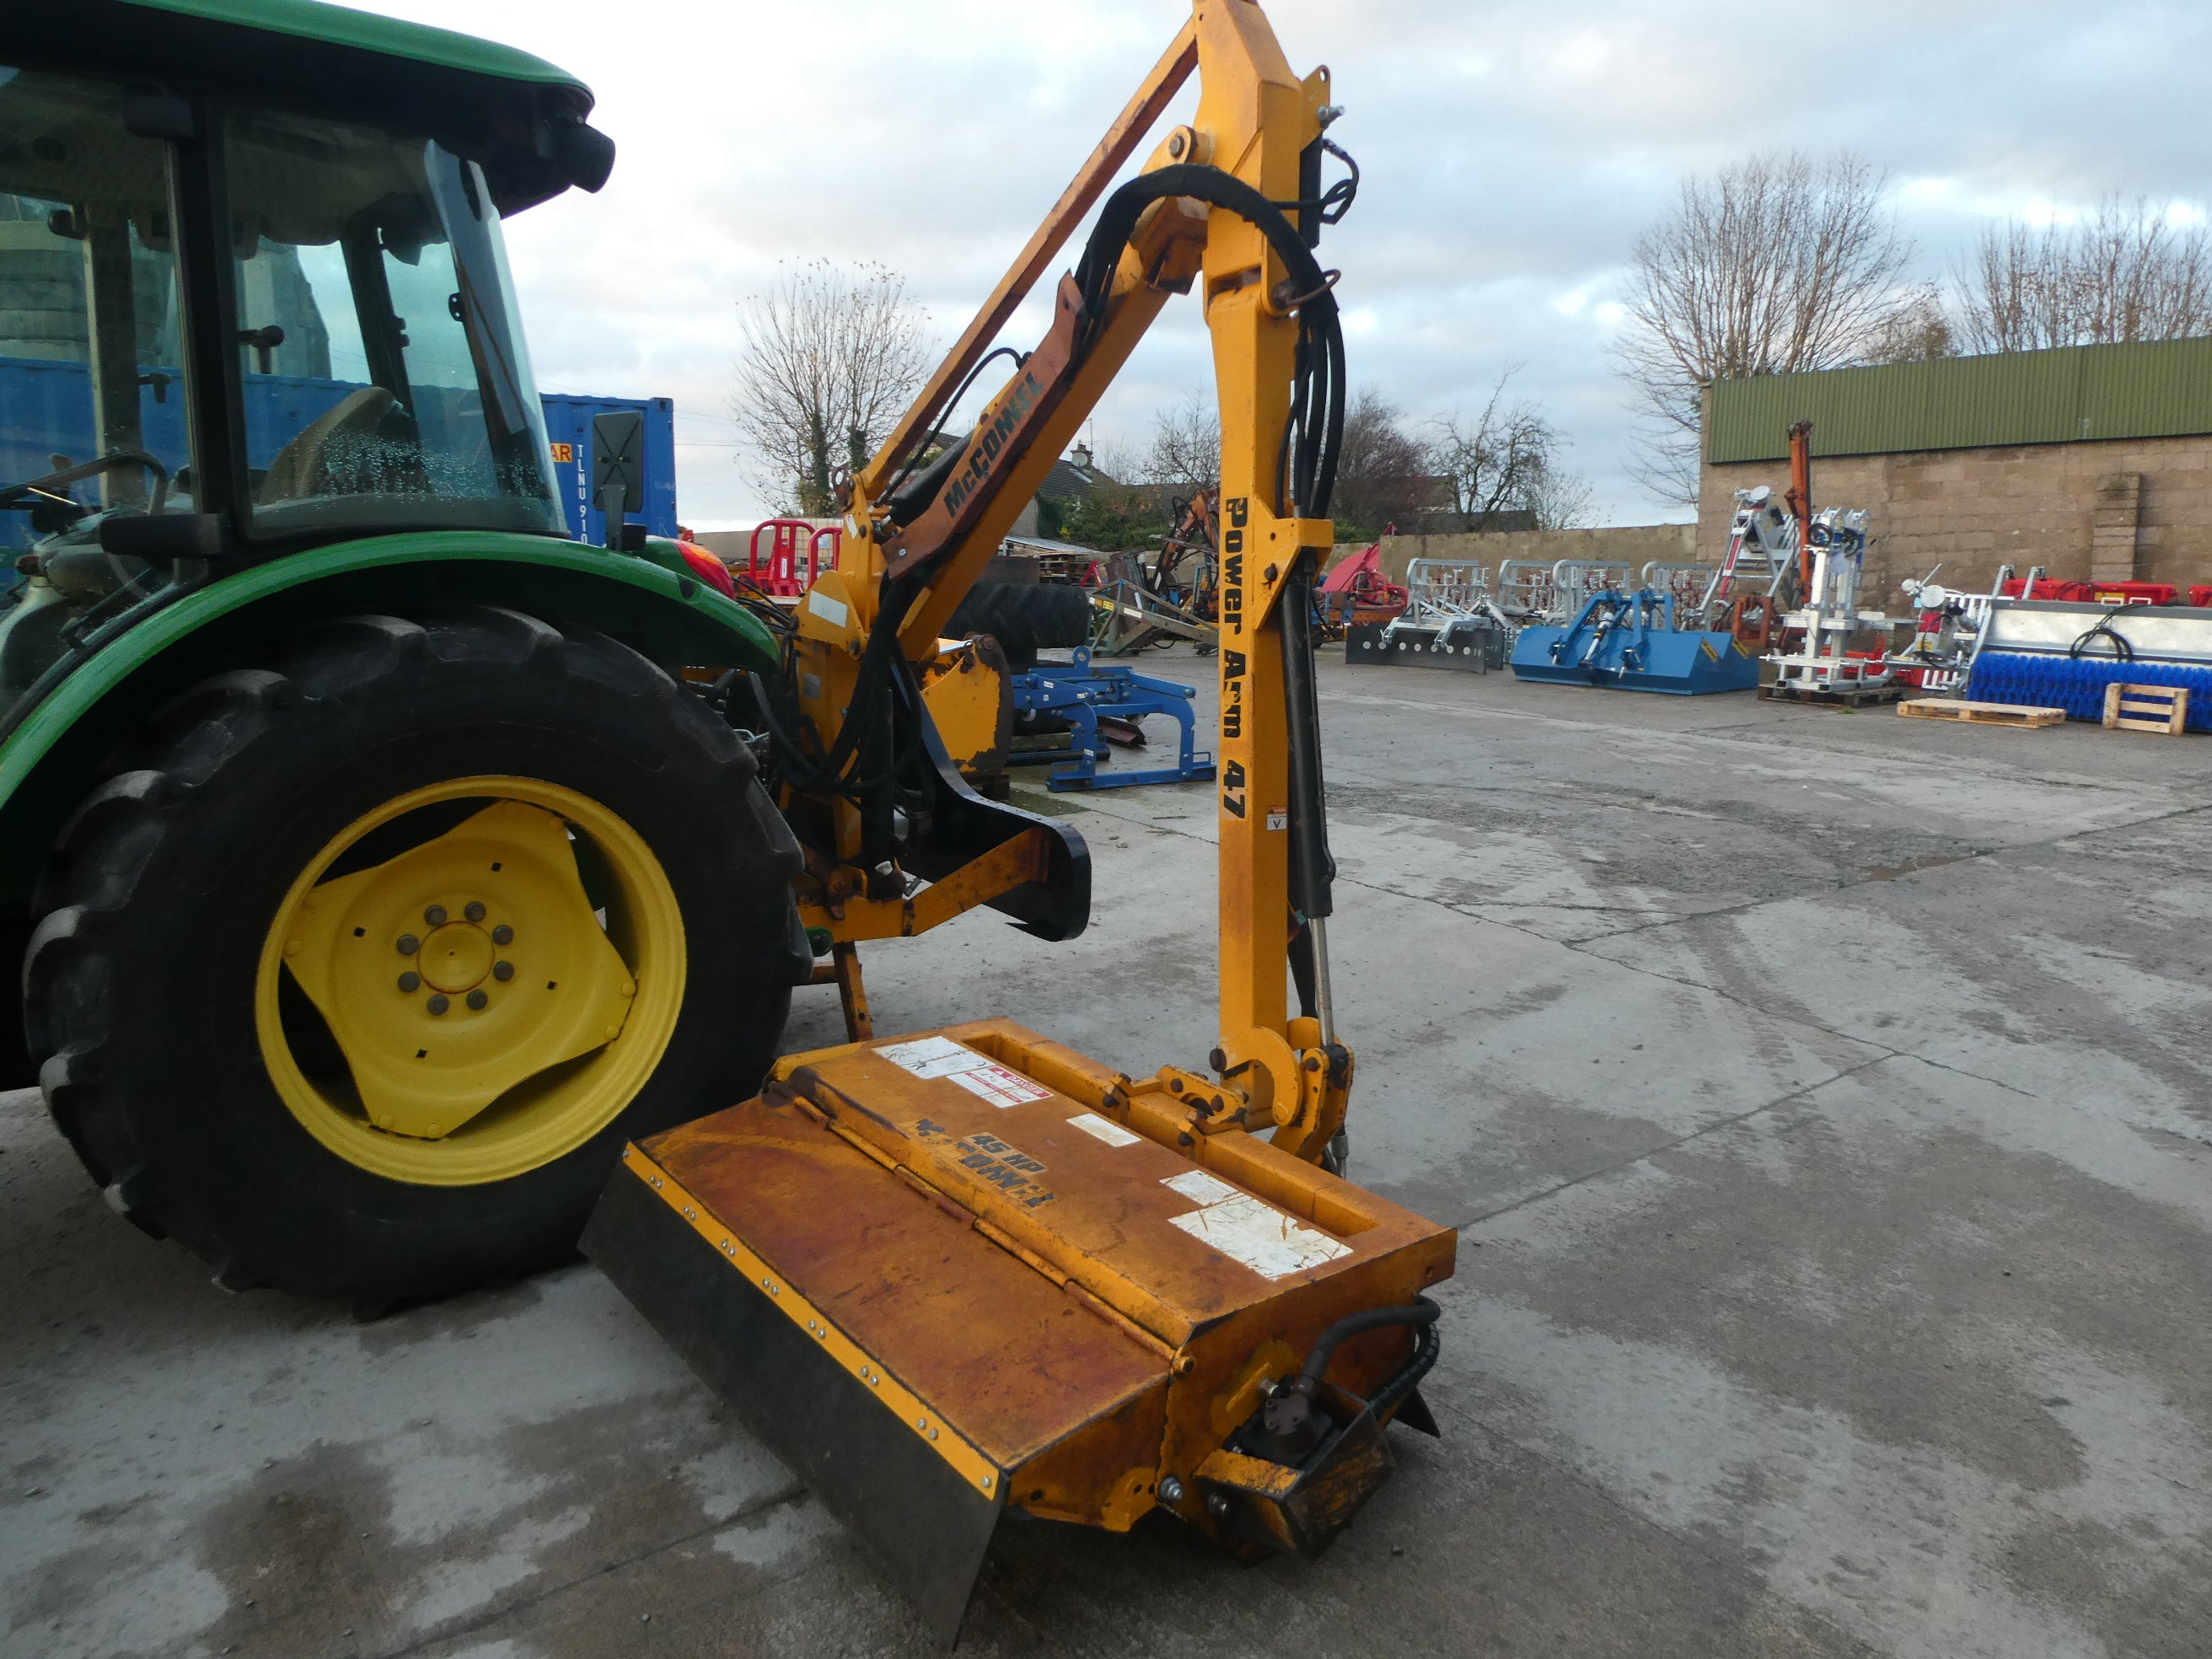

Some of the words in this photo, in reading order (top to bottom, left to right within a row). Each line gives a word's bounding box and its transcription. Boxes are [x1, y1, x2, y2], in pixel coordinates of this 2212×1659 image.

[577, 444, 588, 500] TLNU
[1223, 497, 1248, 636] Power
[1223, 649, 1247, 738] Arm
[1223, 759, 1246, 819] 47
[1007, 1076, 1044, 1096] DANGER
[972, 1135, 1012, 1153] 45
[1002, 1154, 1047, 1173] HP
